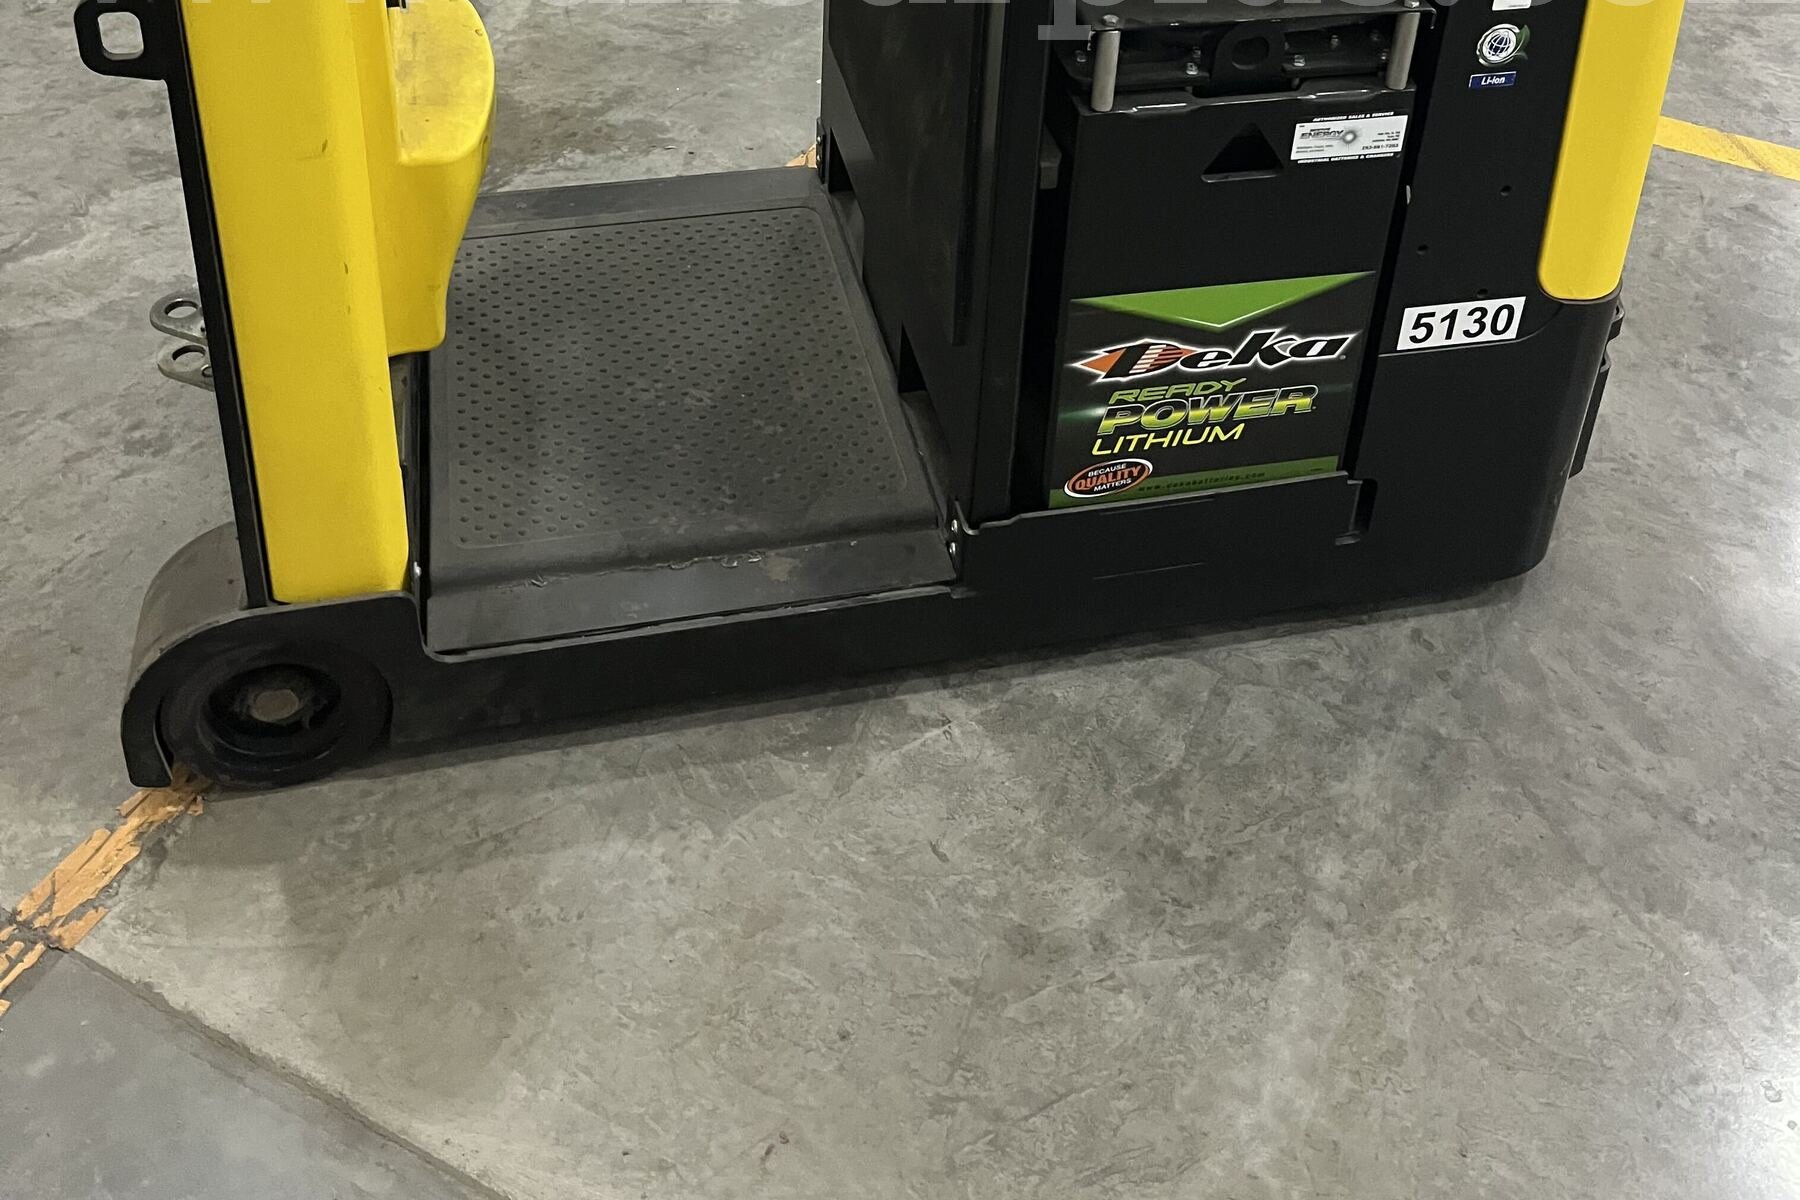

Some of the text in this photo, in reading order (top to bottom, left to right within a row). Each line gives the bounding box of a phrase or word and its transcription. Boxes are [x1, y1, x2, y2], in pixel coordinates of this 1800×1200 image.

[1300, 129, 1345, 139] ENERGY
[1408, 303, 1516, 345] 5130
[1095, 329, 1357, 382] Deka
[1108, 377, 1247, 405] READY
[1097, 383, 1319, 435] POWER
[1091, 422, 1247, 456] LITHIUM
[1075, 464, 1142, 491] QUALITY
[1088, 462, 1127, 477] BECAUSE
[1093, 477, 1132, 492] MATTERS
